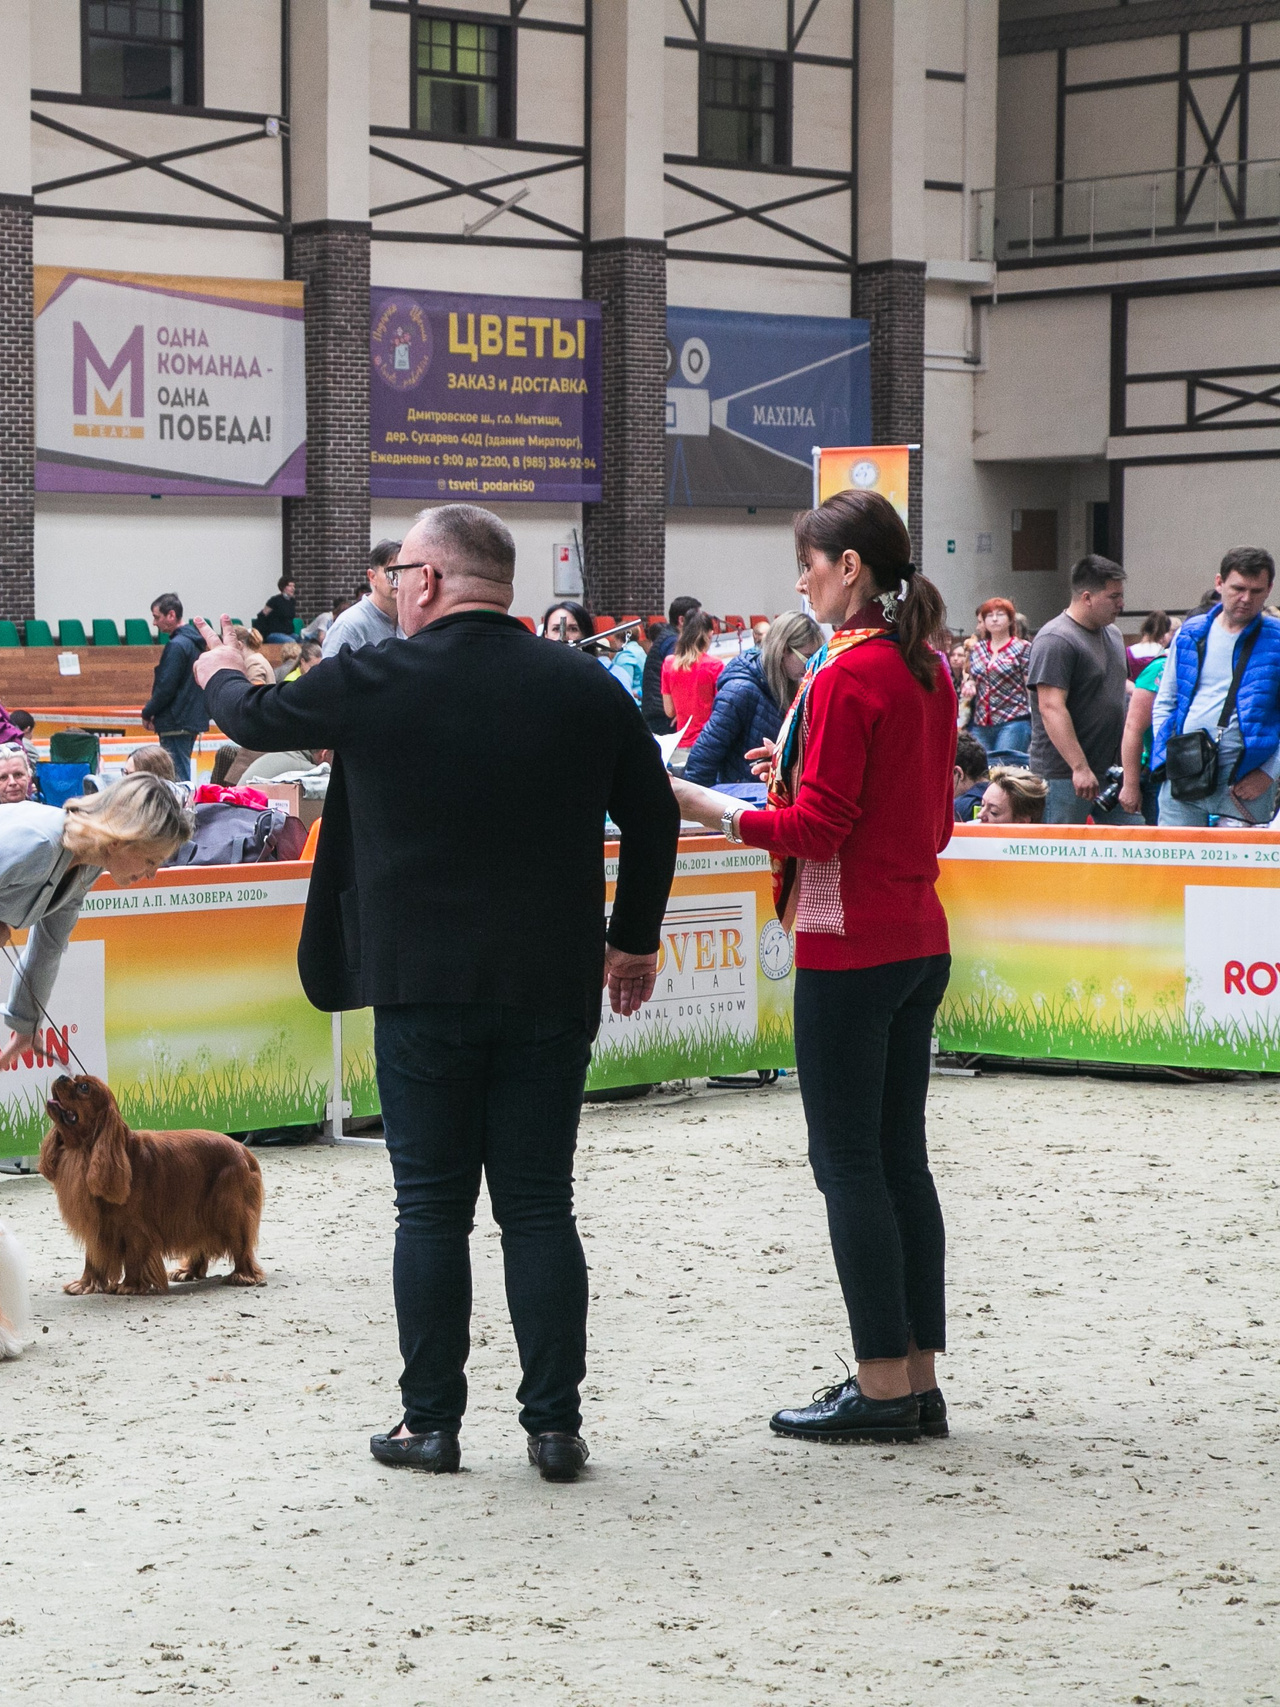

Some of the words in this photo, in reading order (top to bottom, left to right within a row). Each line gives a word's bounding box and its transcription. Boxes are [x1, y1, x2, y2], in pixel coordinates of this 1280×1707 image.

[156, 326, 210, 348] ОДНА
[448, 311, 586, 363] ЦВЕТЫ
[157, 353, 263, 379] КОМАНДА
[447, 372, 497, 391] ЗАКАЗ
[498, 378, 508, 392] и
[511, 376, 589, 394] ДОСТАВКА
[156, 386, 211, 408] ОДНА
[407, 408, 478, 423] Дмитровское
[752, 404, 817, 427] MAXIMA
[86, 426, 133, 438] TEAM
[158, 413, 273, 445] ПОБЕДА!
[385, 431, 409, 443] дер.
[411, 430, 459, 445] Сухарево
[485, 434, 526, 448] (здание
[371, 451, 432, 465] Ежедневно
[442, 453, 464, 466] 9:00
[465, 456, 479, 468] до
[480, 455, 511, 469] 22:00,
[513, 456, 520, 468] 8
[522, 455, 547, 471] (985)
[548, 456, 597, 470] 384-92-94
[448, 477, 536, 493] tsveti_podarki50
[1002, 844, 1087, 858] «МЕМОРИАЛ
[1091, 846, 1117, 859] А.П.
[1122, 847, 1196, 861] МАЗОВЕРА
[142, 894, 166, 908] А.П.
[169, 890, 233, 906] МАЗОВЕРА
[678, 1003, 702, 1017] DOG
[709, 1000, 747, 1013] SHOW
